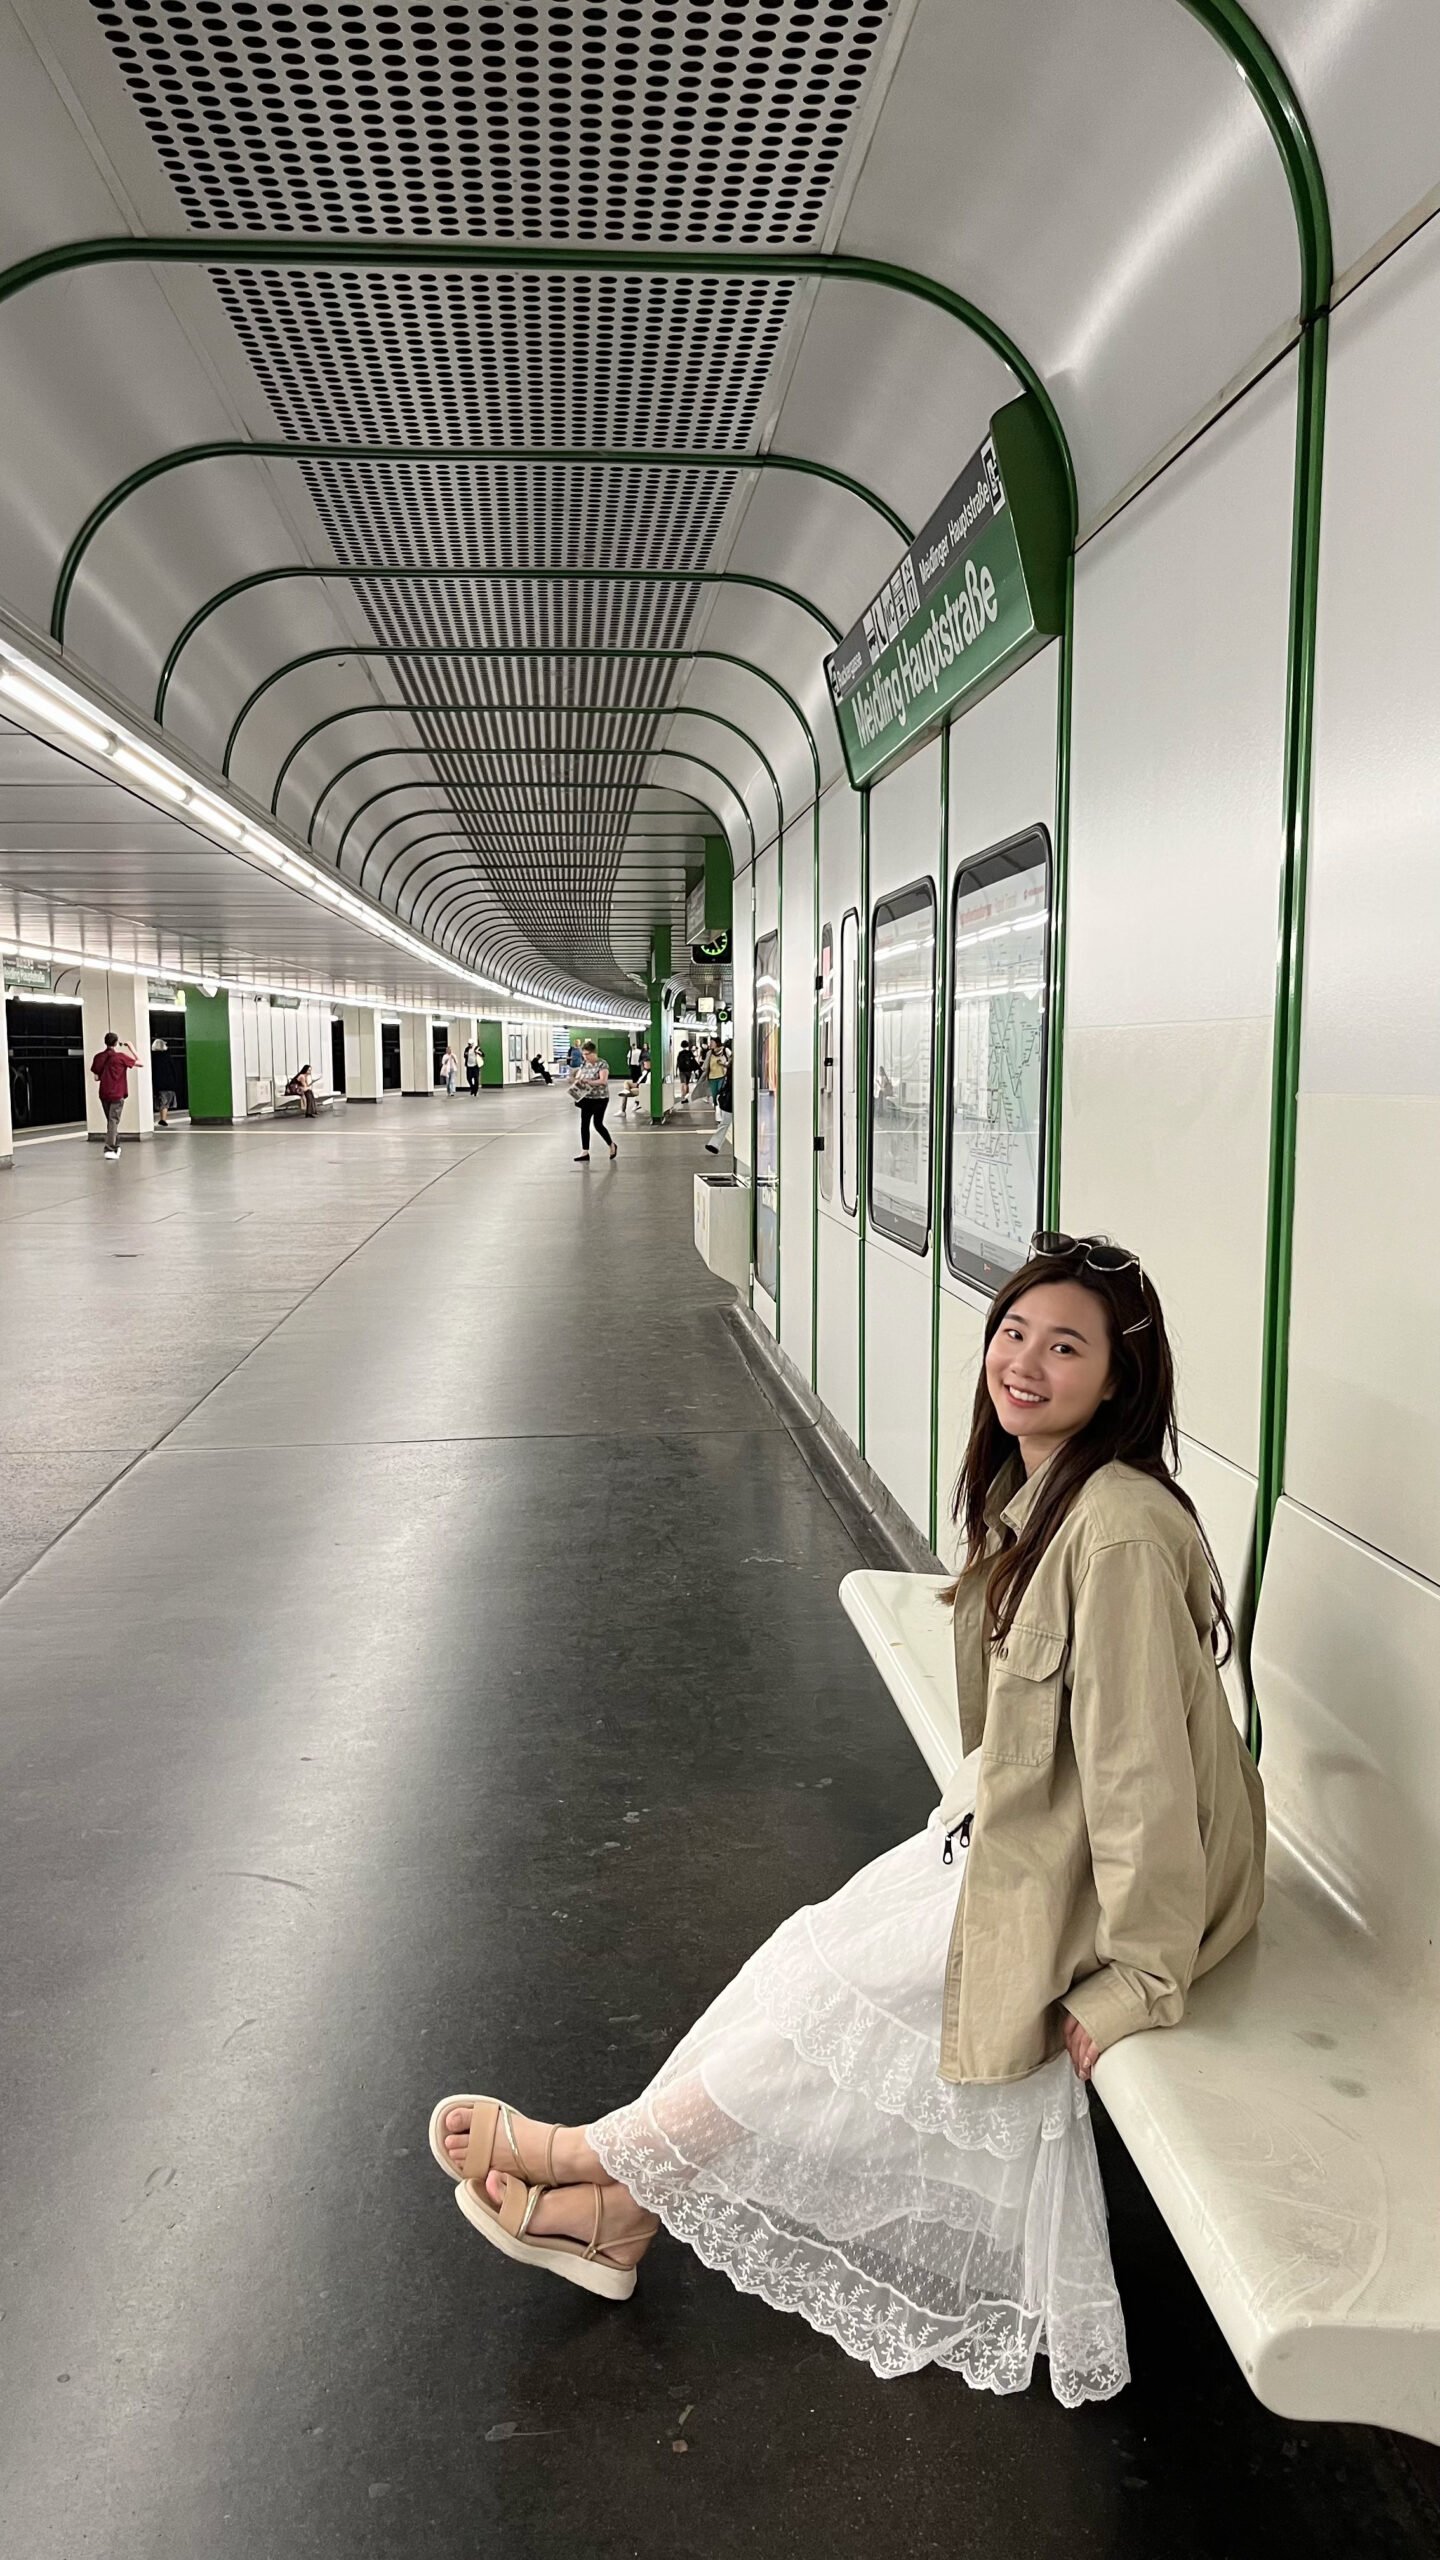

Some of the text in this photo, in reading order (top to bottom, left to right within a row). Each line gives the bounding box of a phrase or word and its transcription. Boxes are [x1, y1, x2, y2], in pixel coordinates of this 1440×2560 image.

[918, 481, 990, 585] Meidlinger Hauptstraße
[851, 559, 998, 748] Meidling Hauptstraße
